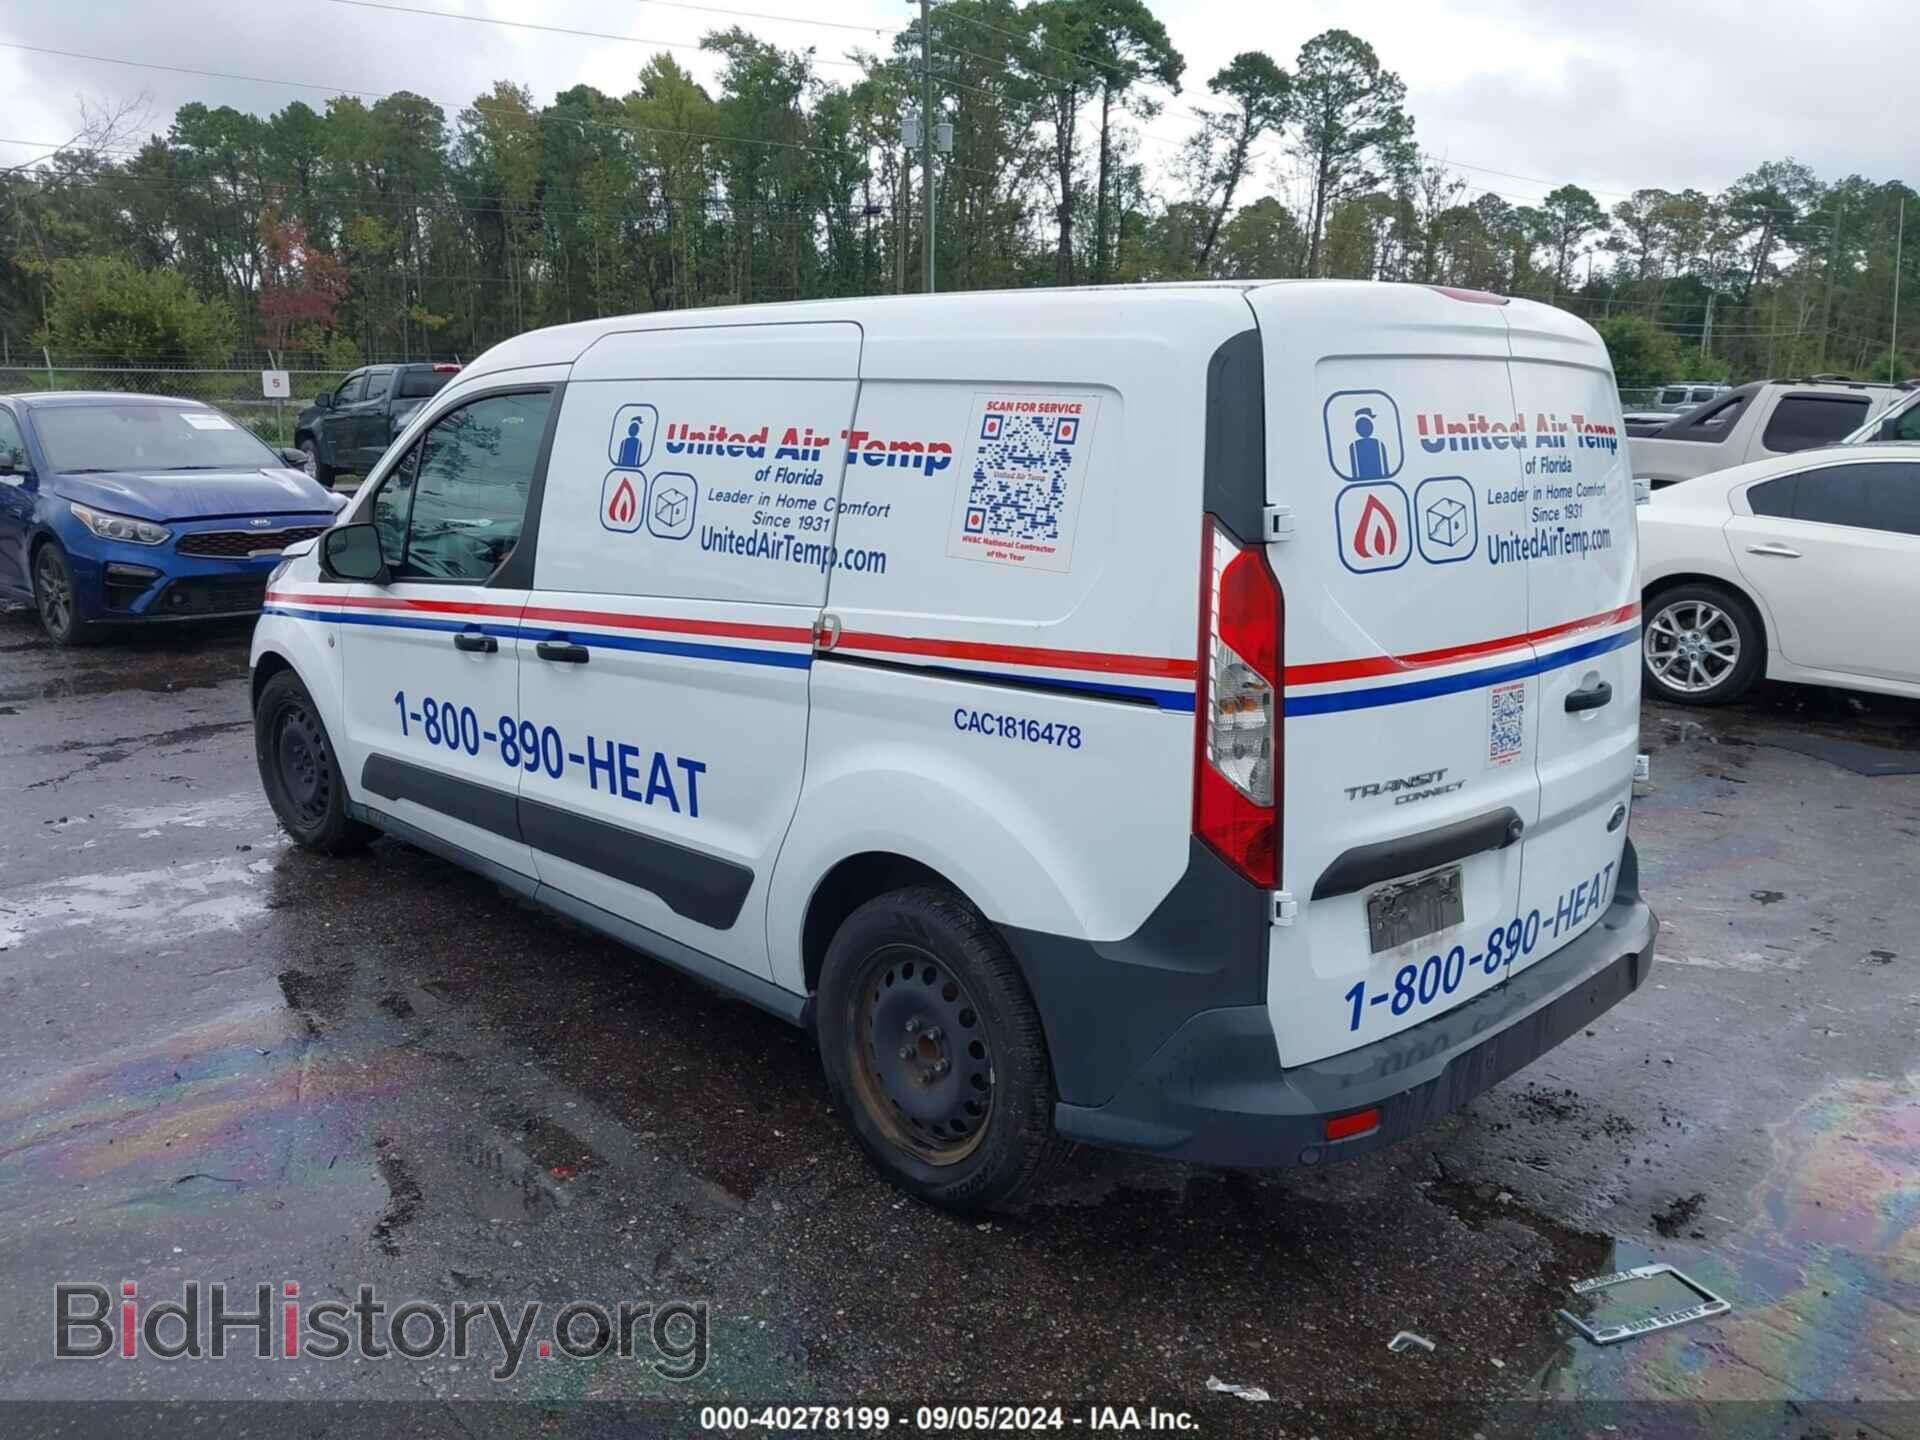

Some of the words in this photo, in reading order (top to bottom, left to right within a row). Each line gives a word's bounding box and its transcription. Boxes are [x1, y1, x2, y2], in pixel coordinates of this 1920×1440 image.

[272, 378, 280, 388] 5
[986, 401, 1014, 411] SCAN
[1015, 402, 1037, 412] FOR
[1038, 403, 1082, 414] SERVICE
[1417, 413, 1527, 453] United
[1536, 413, 1568, 449] Air
[1571, 414, 1618, 455] Temp
[666, 423, 769, 459] United
[775, 427, 830, 462] Air
[841, 429, 952, 477] Temp
[755, 464, 771, 482] of
[774, 466, 823, 486] Florida
[1525, 456, 1537, 474] of
[1540, 455, 1573, 474] Florida
[708, 487, 753, 505] Leader
[758, 491, 771, 505] in
[776, 494, 817, 511] Home
[823, 497, 891, 518] Comfort
[1488, 487, 1529, 505] Leader
[1533, 486, 1542, 501] in
[1546, 484, 1573, 500] Home
[1576, 482, 1606, 497] Comfort
[752, 510, 791, 529] Since
[798, 515, 830, 532] 1931
[1531, 506, 1560, 523] Since
[1564, 503, 1583, 519] 1931
[701, 525, 887, 574] UnitedAirTemp.com
[962, 535, 982, 544] HVAC
[983, 537, 1015, 548] National
[1015, 541, 1056, 553] Contractor
[1009, 552, 1025, 561] Year
[1487, 526, 1612, 566] UnitedAirTemp.com
[954, 708, 1081, 749] CAC1816478
[394, 690, 707, 818] 1-800-890-HEAT
[1344, 768, 1448, 801] TRANSIT
[1395, 779, 1467, 806] CONNECT
[1345, 861, 1615, 1033] 1-800-890-HEAT
